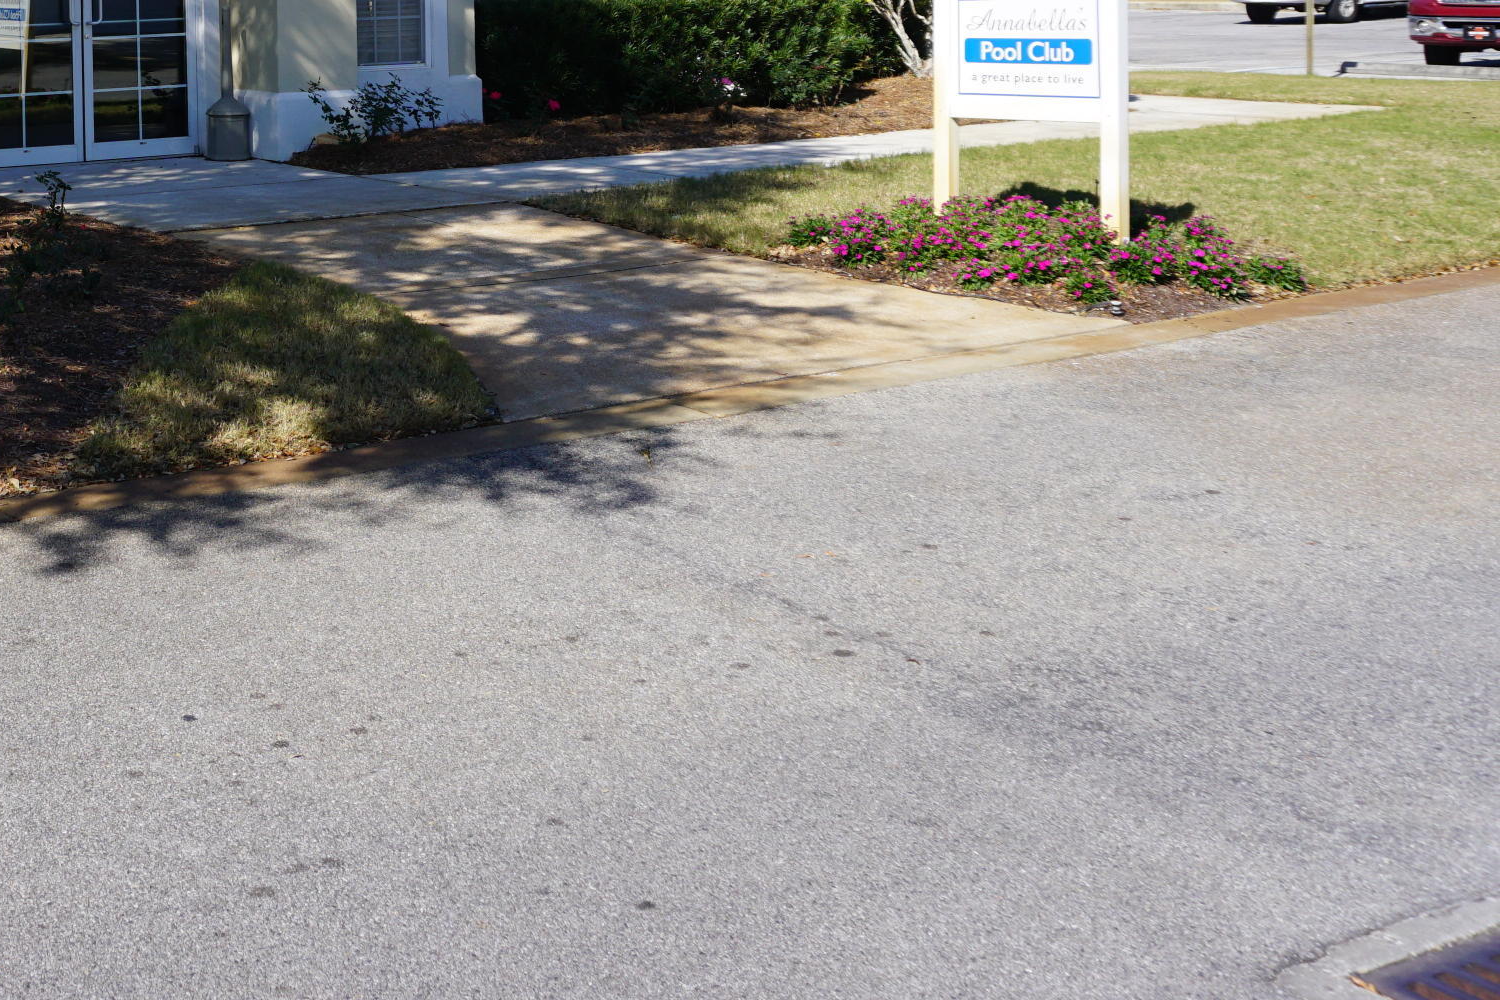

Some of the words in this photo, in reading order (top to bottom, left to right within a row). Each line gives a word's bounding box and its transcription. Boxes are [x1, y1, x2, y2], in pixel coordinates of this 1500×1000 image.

[966, 6, 1087, 31] Annabella's
[980, 40, 1022, 61] Pool
[1027, 41, 1075, 62] Club
[971, 73, 978, 81] a
[981, 73, 1010, 85] great
[1014, 72, 1044, 86] place
[1047, 75, 1060, 84] to
[1064, 74, 1085, 85] live
